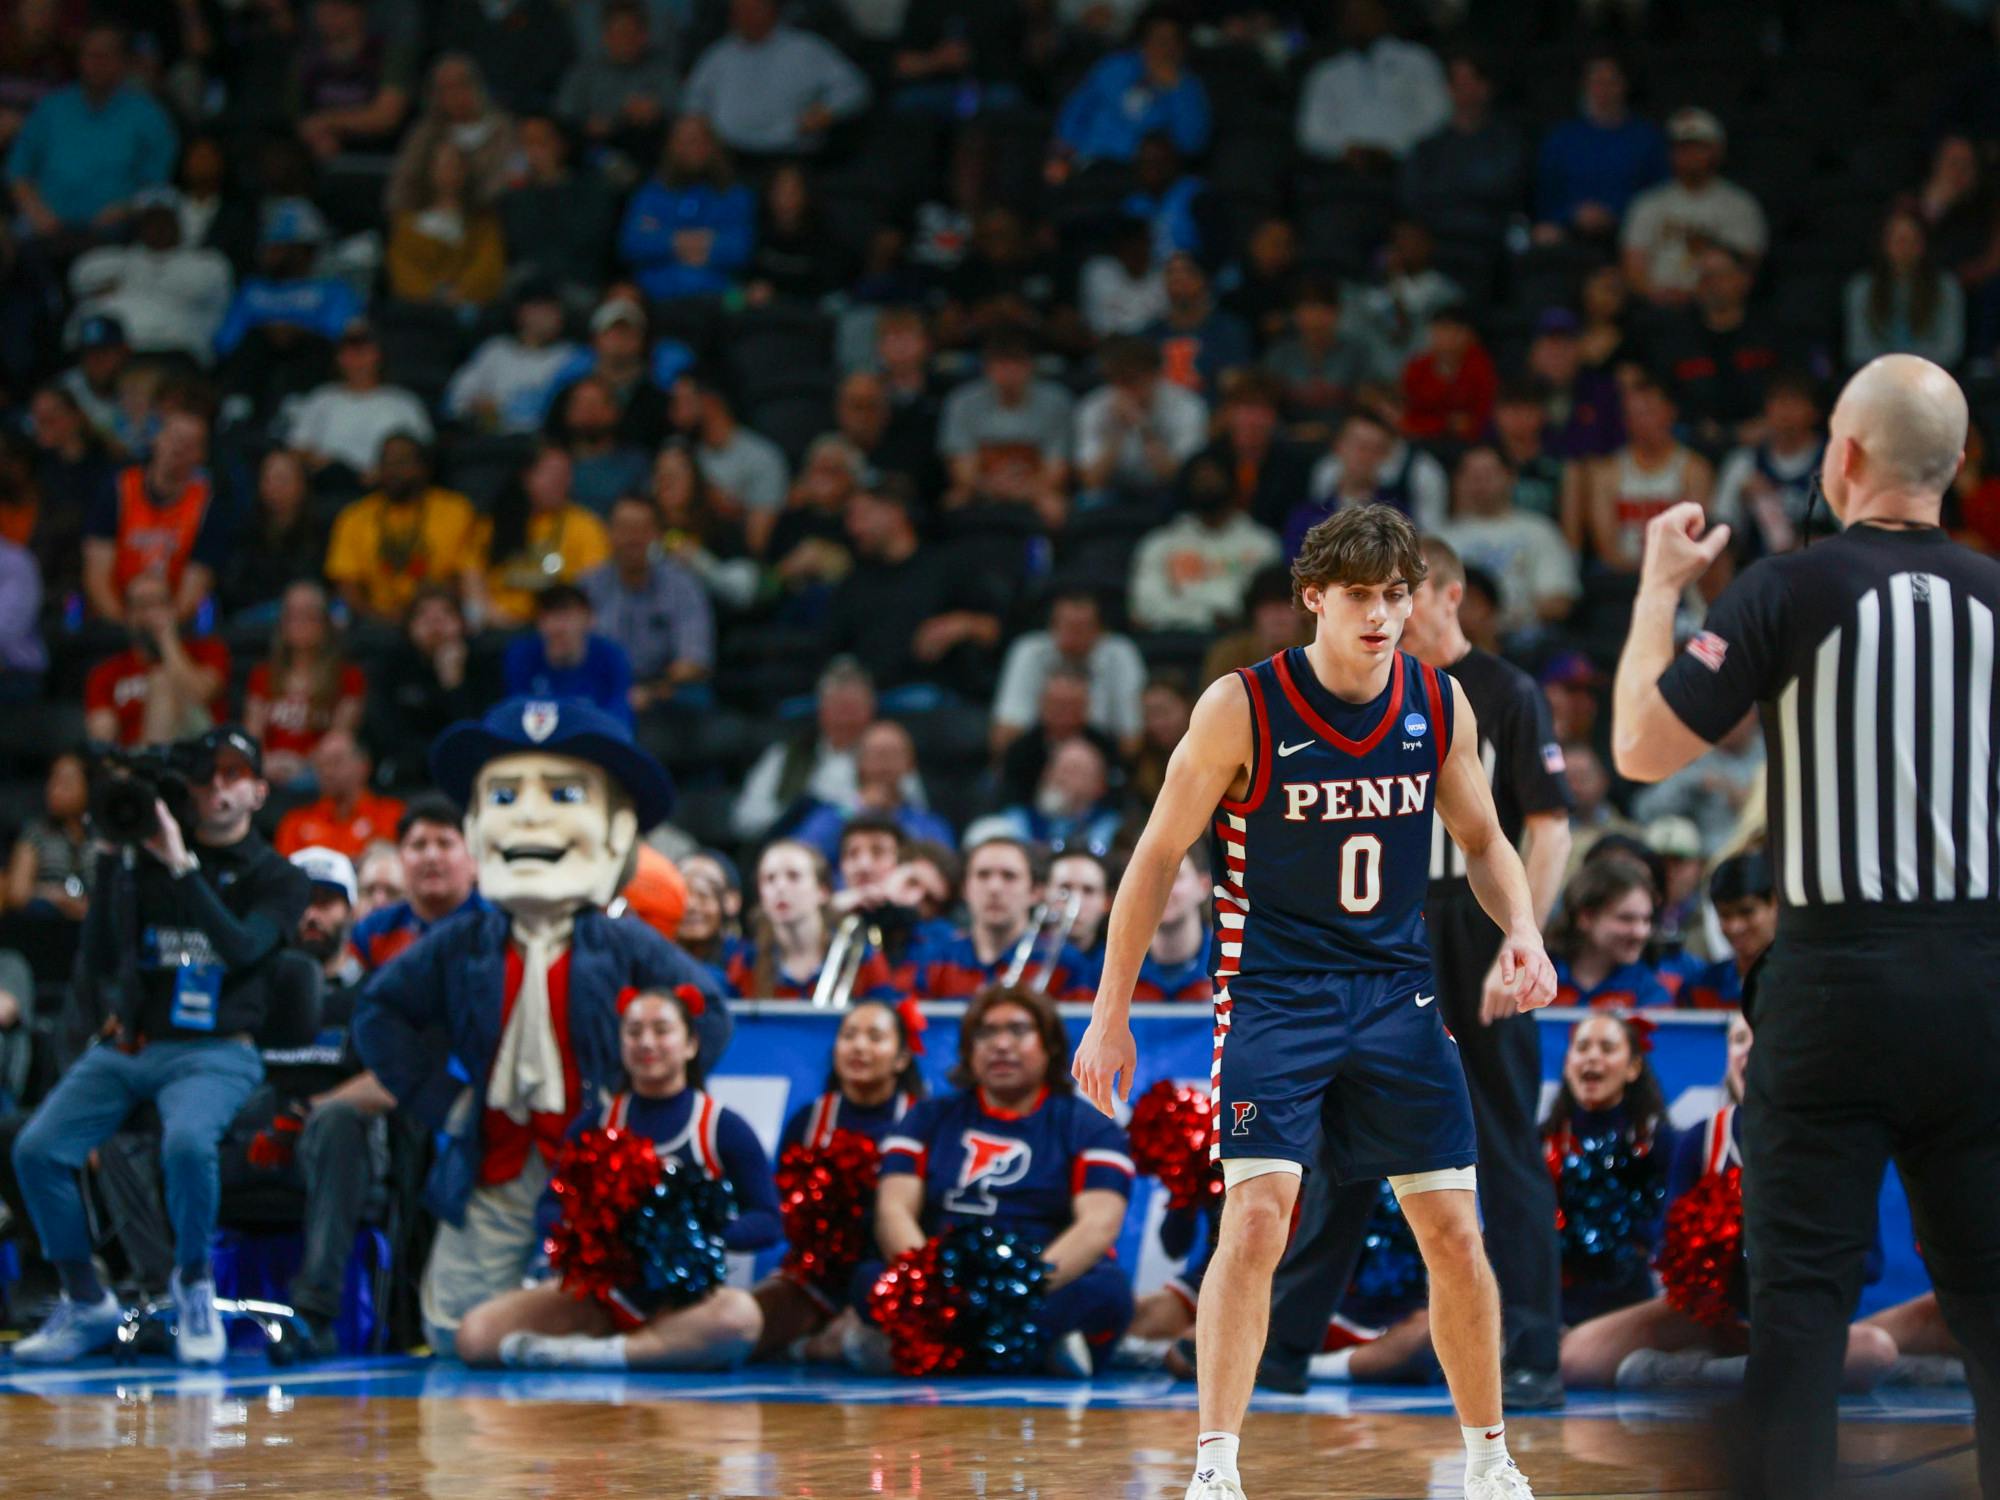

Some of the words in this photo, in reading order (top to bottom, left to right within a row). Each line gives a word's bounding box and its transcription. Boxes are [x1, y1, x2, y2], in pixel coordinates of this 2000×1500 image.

[1402, 741, 1415, 751] Ivy
[1284, 772, 1431, 821] PENN
[1340, 833, 1382, 913] 0
[1232, 1101, 1257, 1136] P
[944, 1129, 1032, 1215] P
